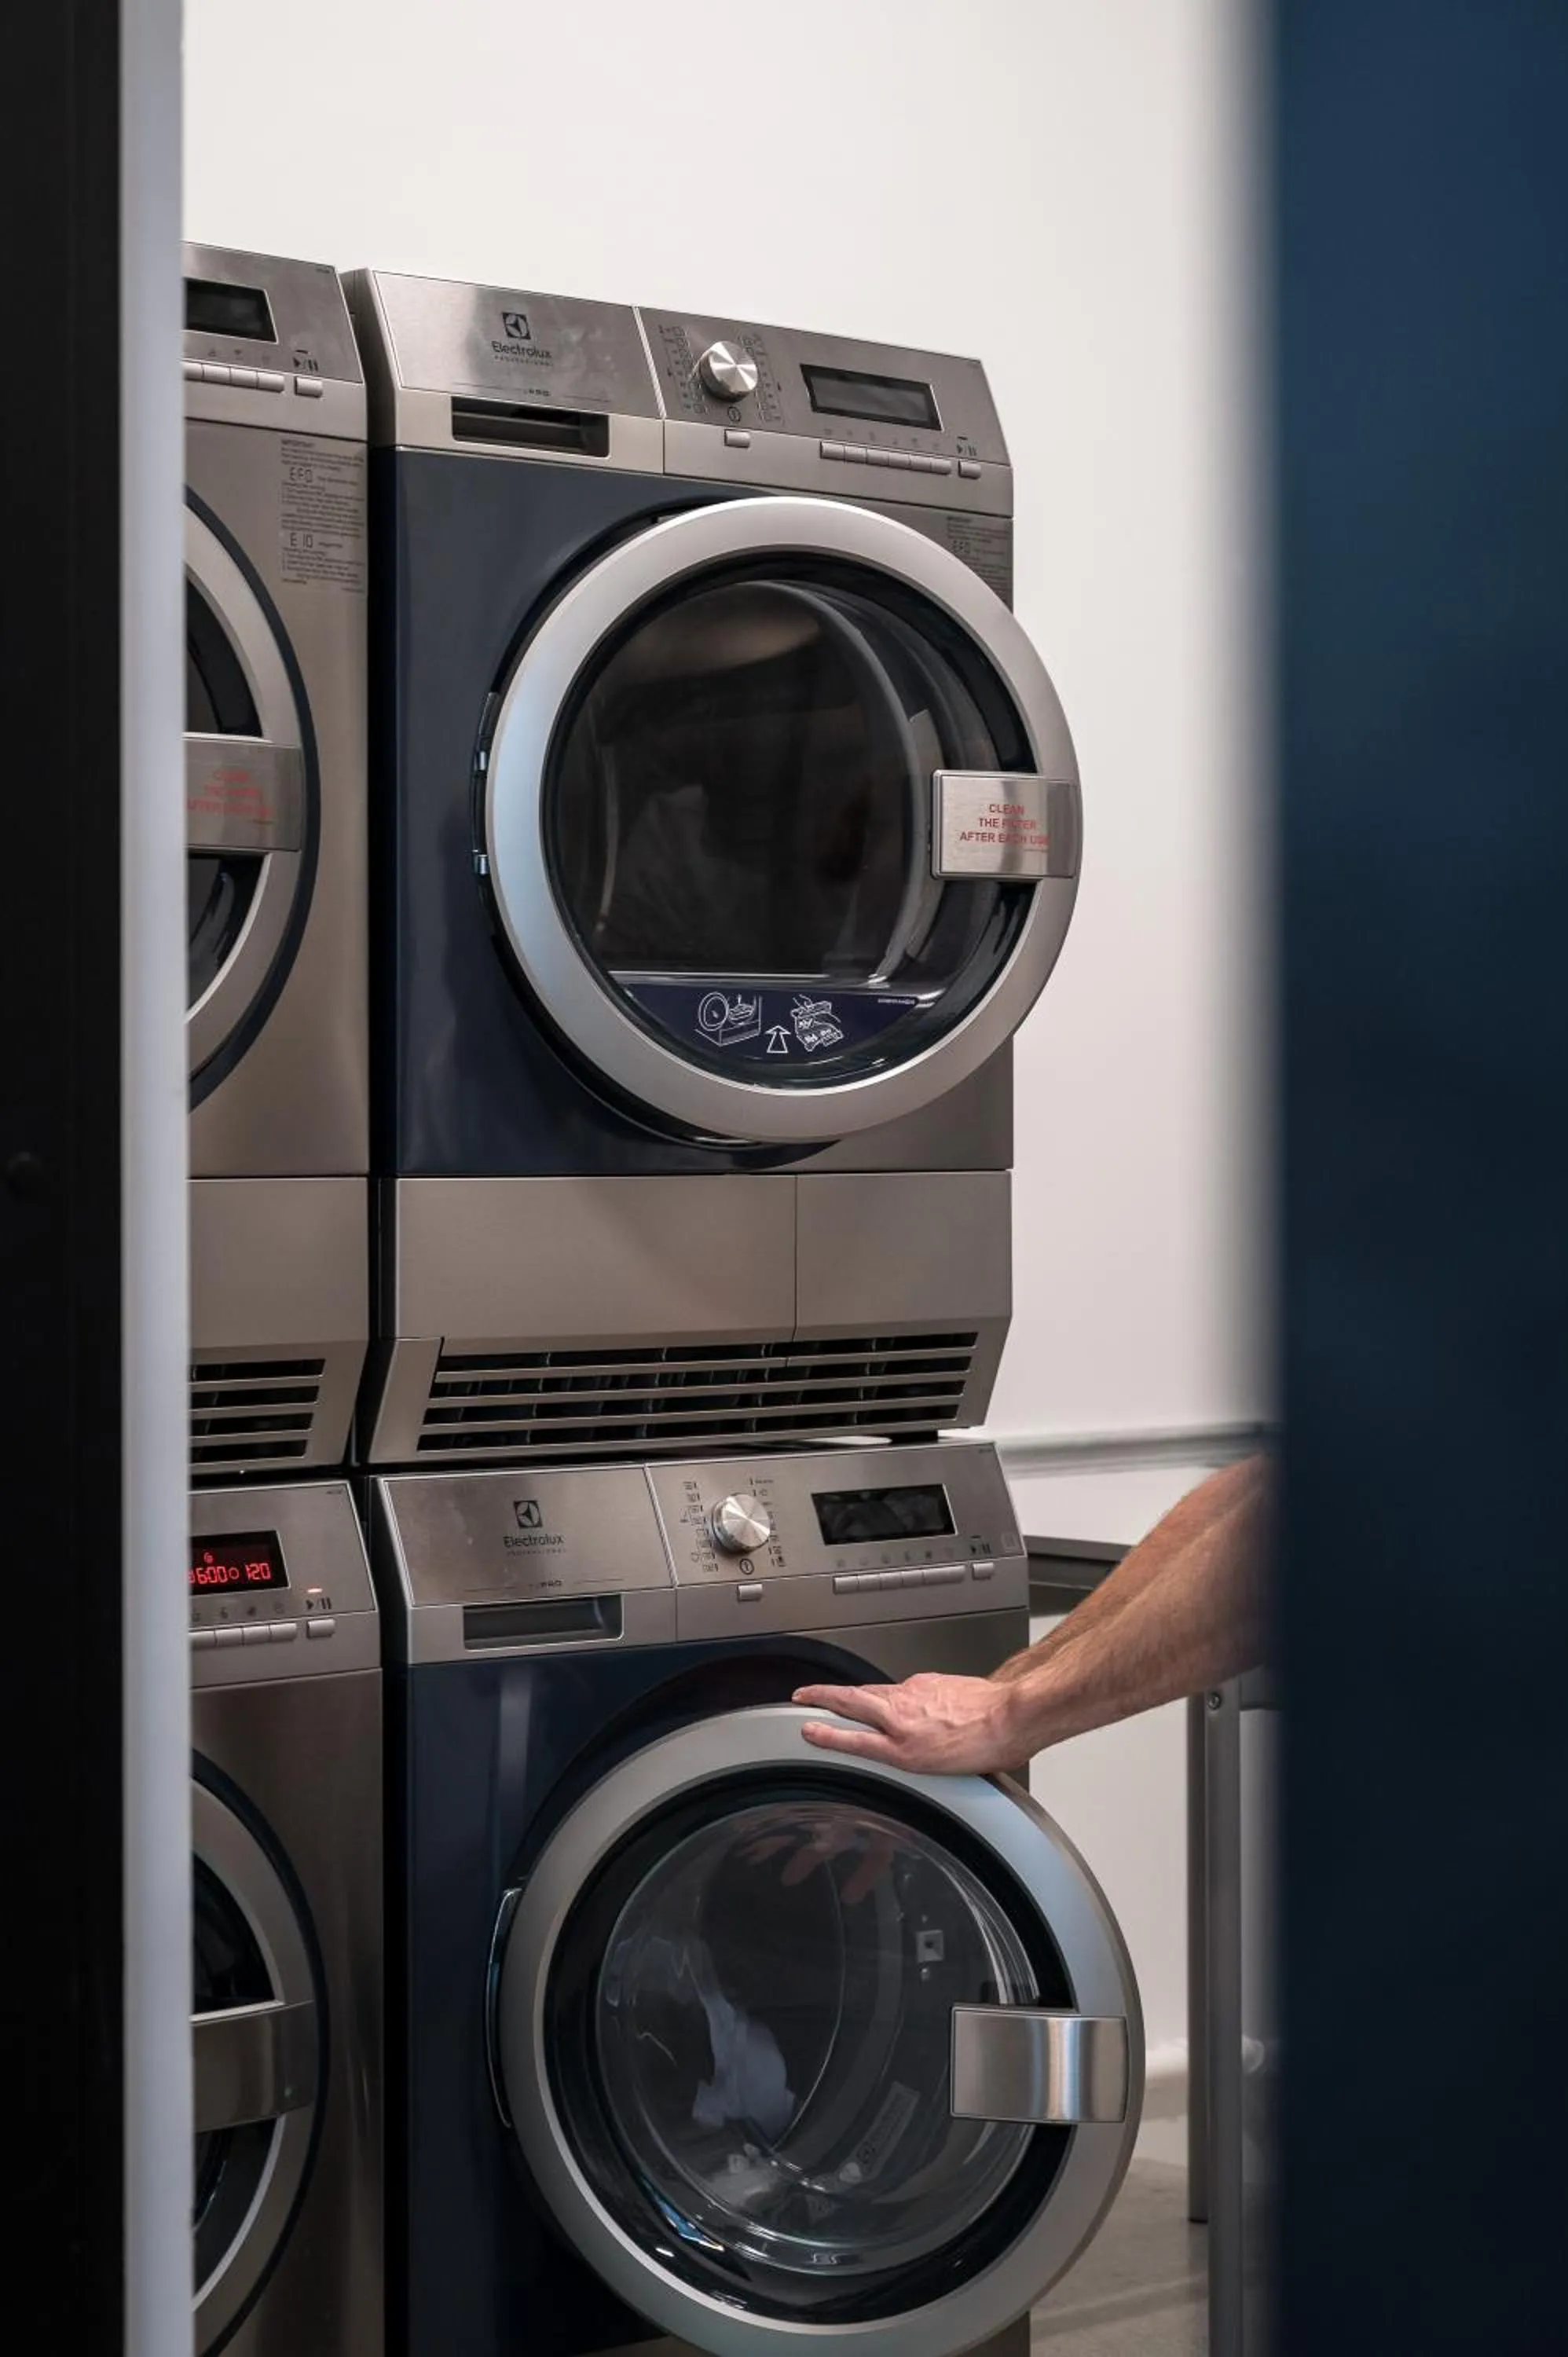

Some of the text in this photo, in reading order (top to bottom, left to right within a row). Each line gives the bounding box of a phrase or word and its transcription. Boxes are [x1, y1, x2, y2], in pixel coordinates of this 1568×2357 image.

[491, 340, 552, 359] Electrolux
[989, 804, 1024, 815] CLEAN
[979, 818, 1000, 827] THE
[960, 832, 995, 843] AFTER
[998, 833, 1027, 844] EACH
[503, 1533, 565, 1548] Electrolux
